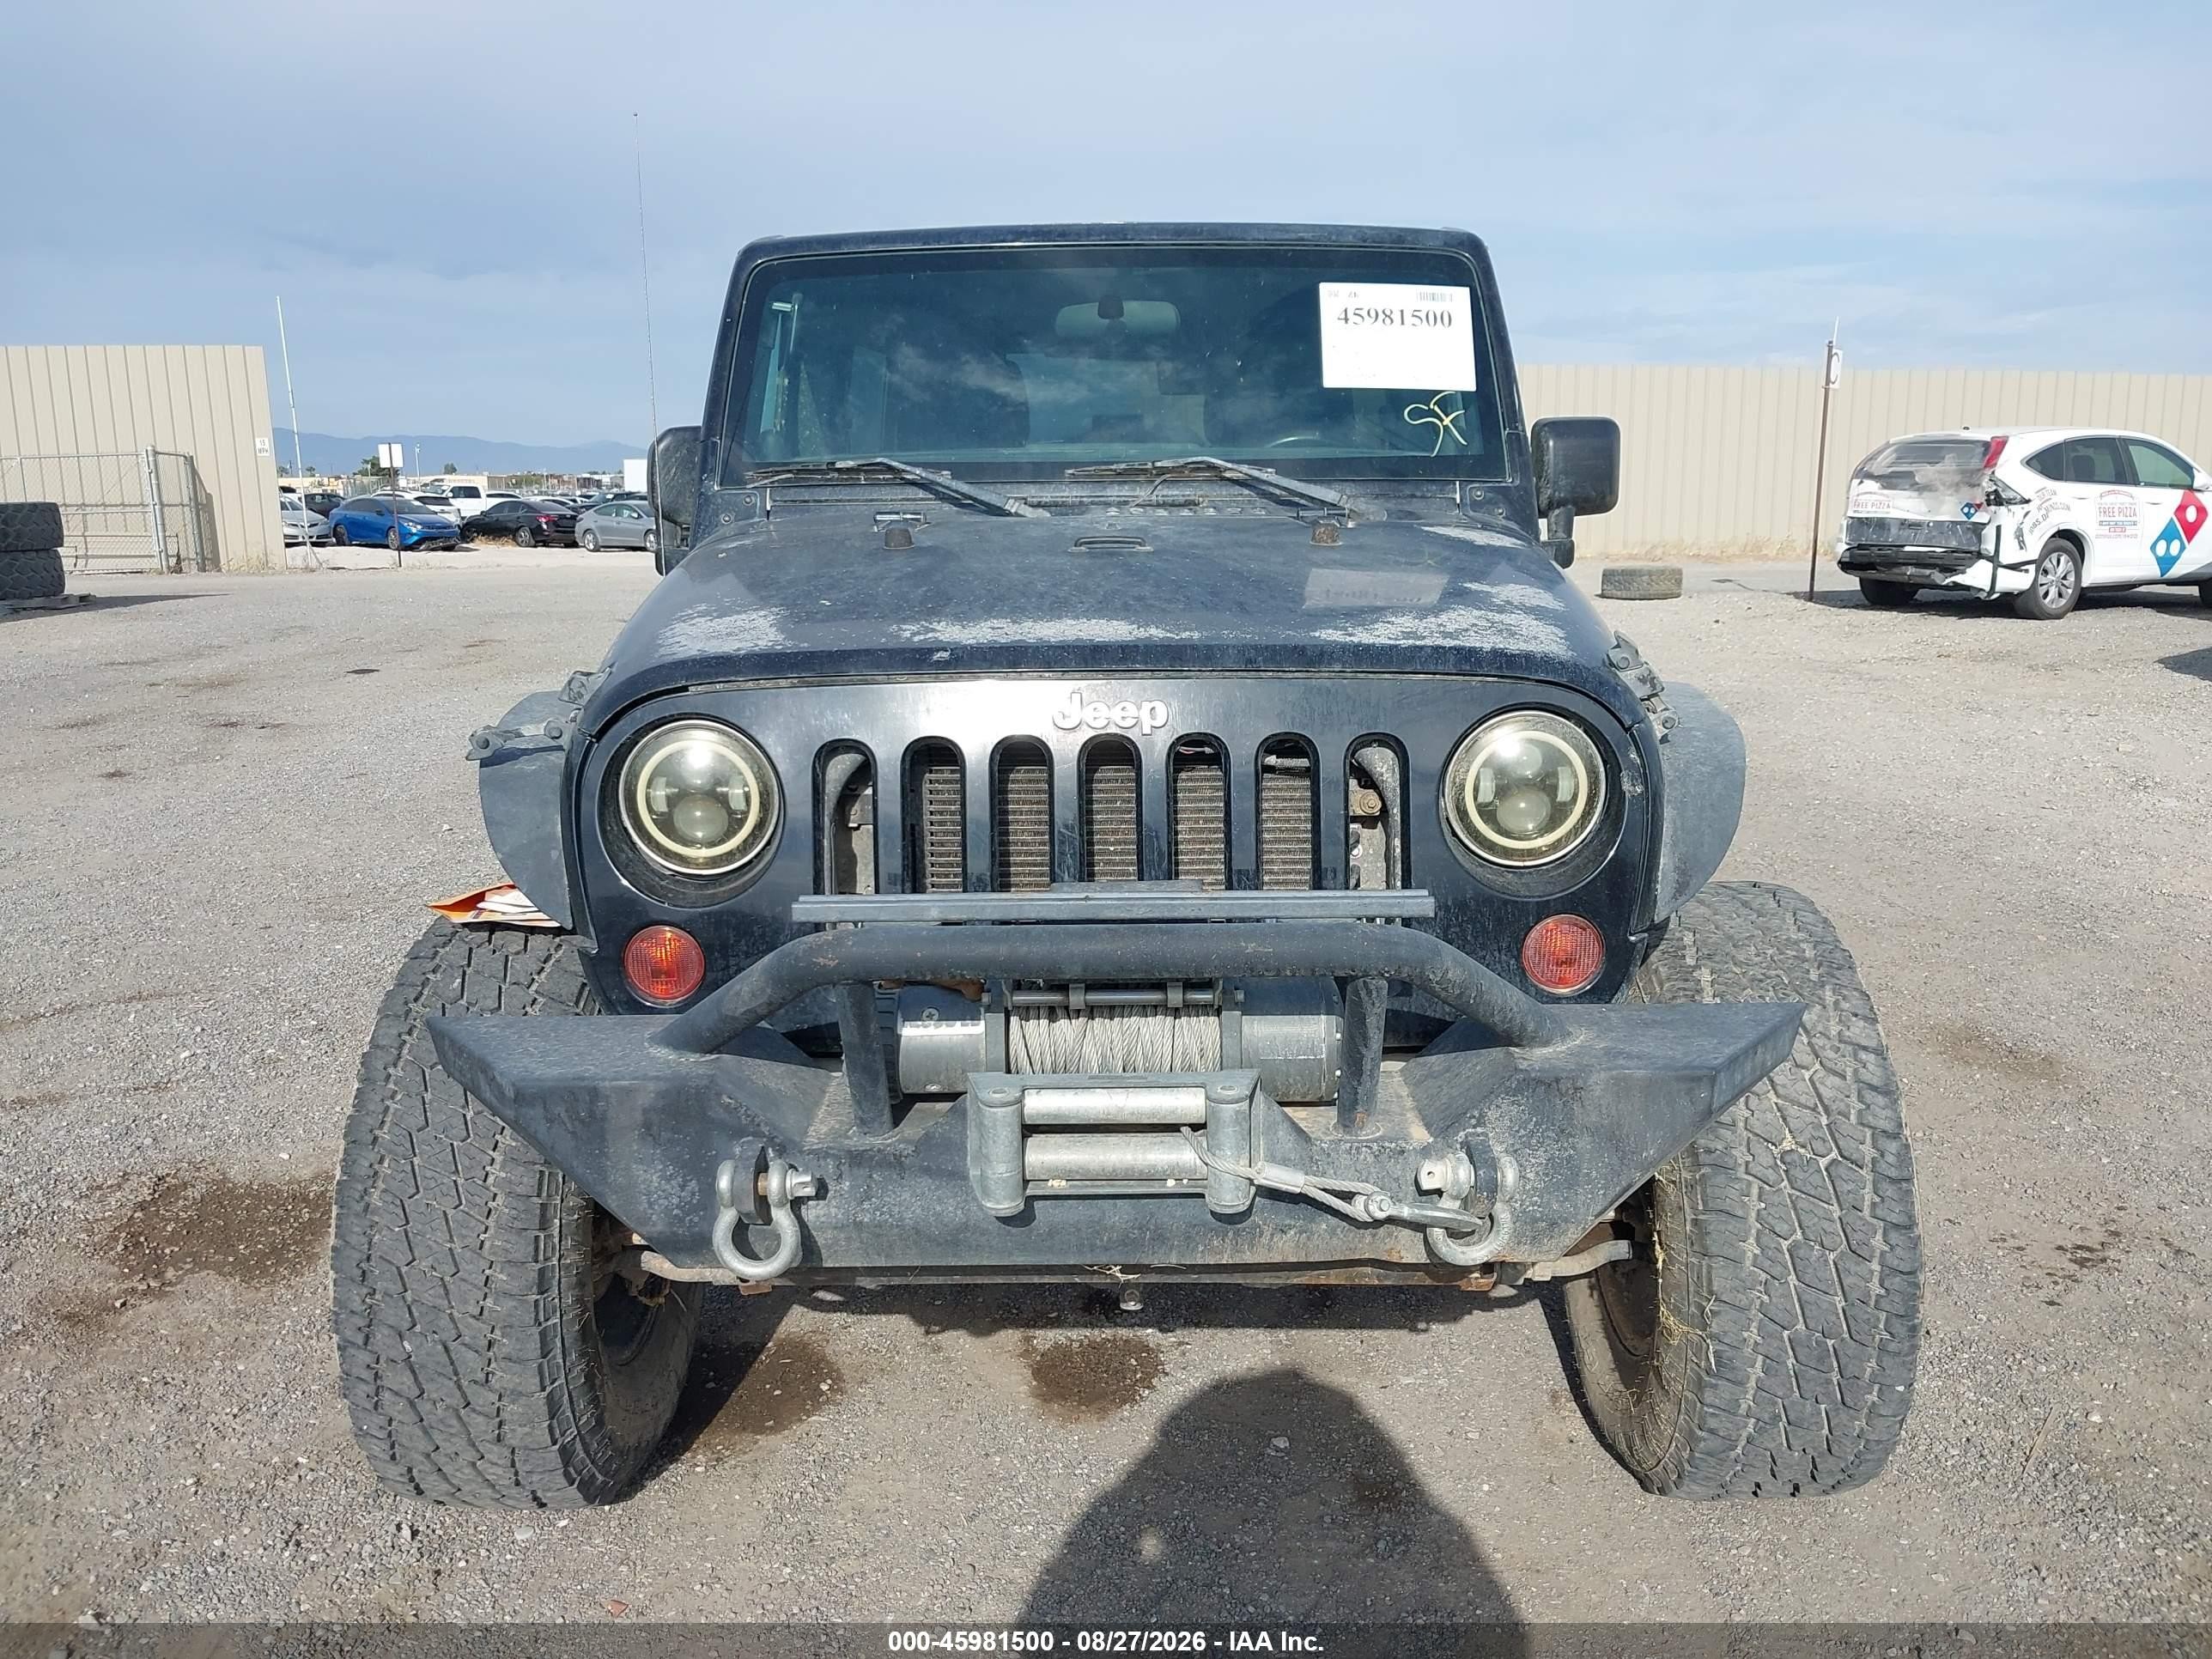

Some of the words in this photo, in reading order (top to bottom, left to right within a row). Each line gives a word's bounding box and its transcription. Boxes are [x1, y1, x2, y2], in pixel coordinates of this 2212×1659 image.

[1337, 307, 1453, 328] 45981500
[2099, 507, 2116, 517] FREE
[2118, 507, 2137, 518] PIZZA
[1052, 691, 1170, 736] Jeep
